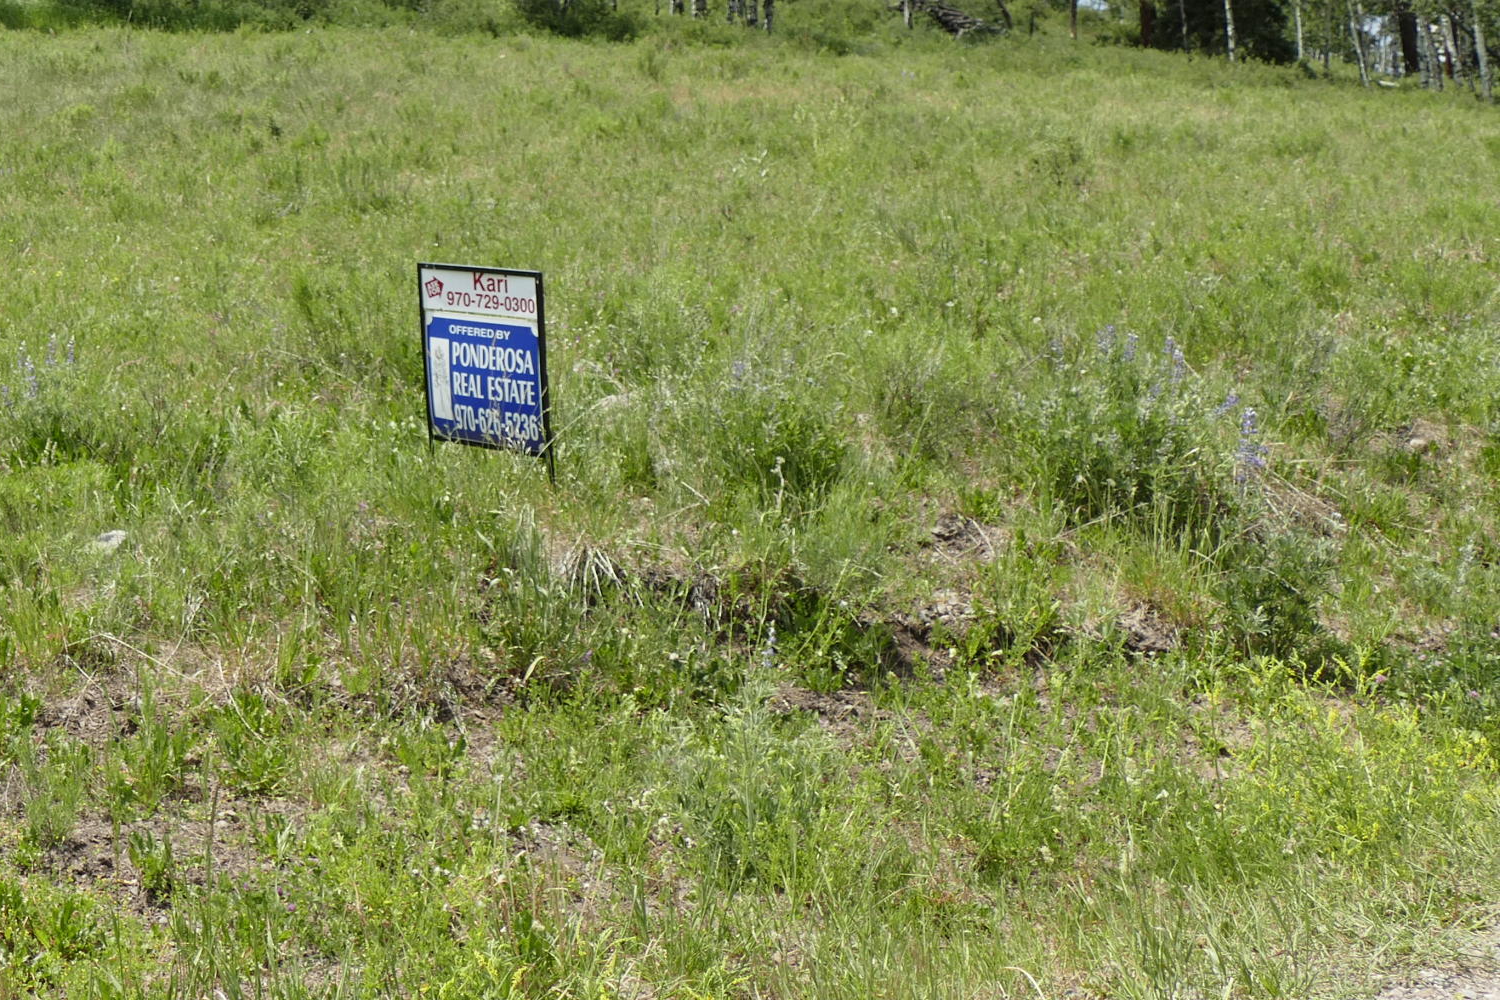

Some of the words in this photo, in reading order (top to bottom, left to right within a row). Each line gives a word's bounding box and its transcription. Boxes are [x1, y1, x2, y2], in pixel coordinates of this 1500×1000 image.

[473, 271, 507, 293] Kari
[447, 291, 535, 314] 970-729-0300
[449, 324, 494, 339] OFFERED
[496, 329, 510, 340] BY
[452, 341, 534, 375] PONDEROSA
[453, 371, 484, 398] REAL
[487, 376, 535, 405] ESTATE
